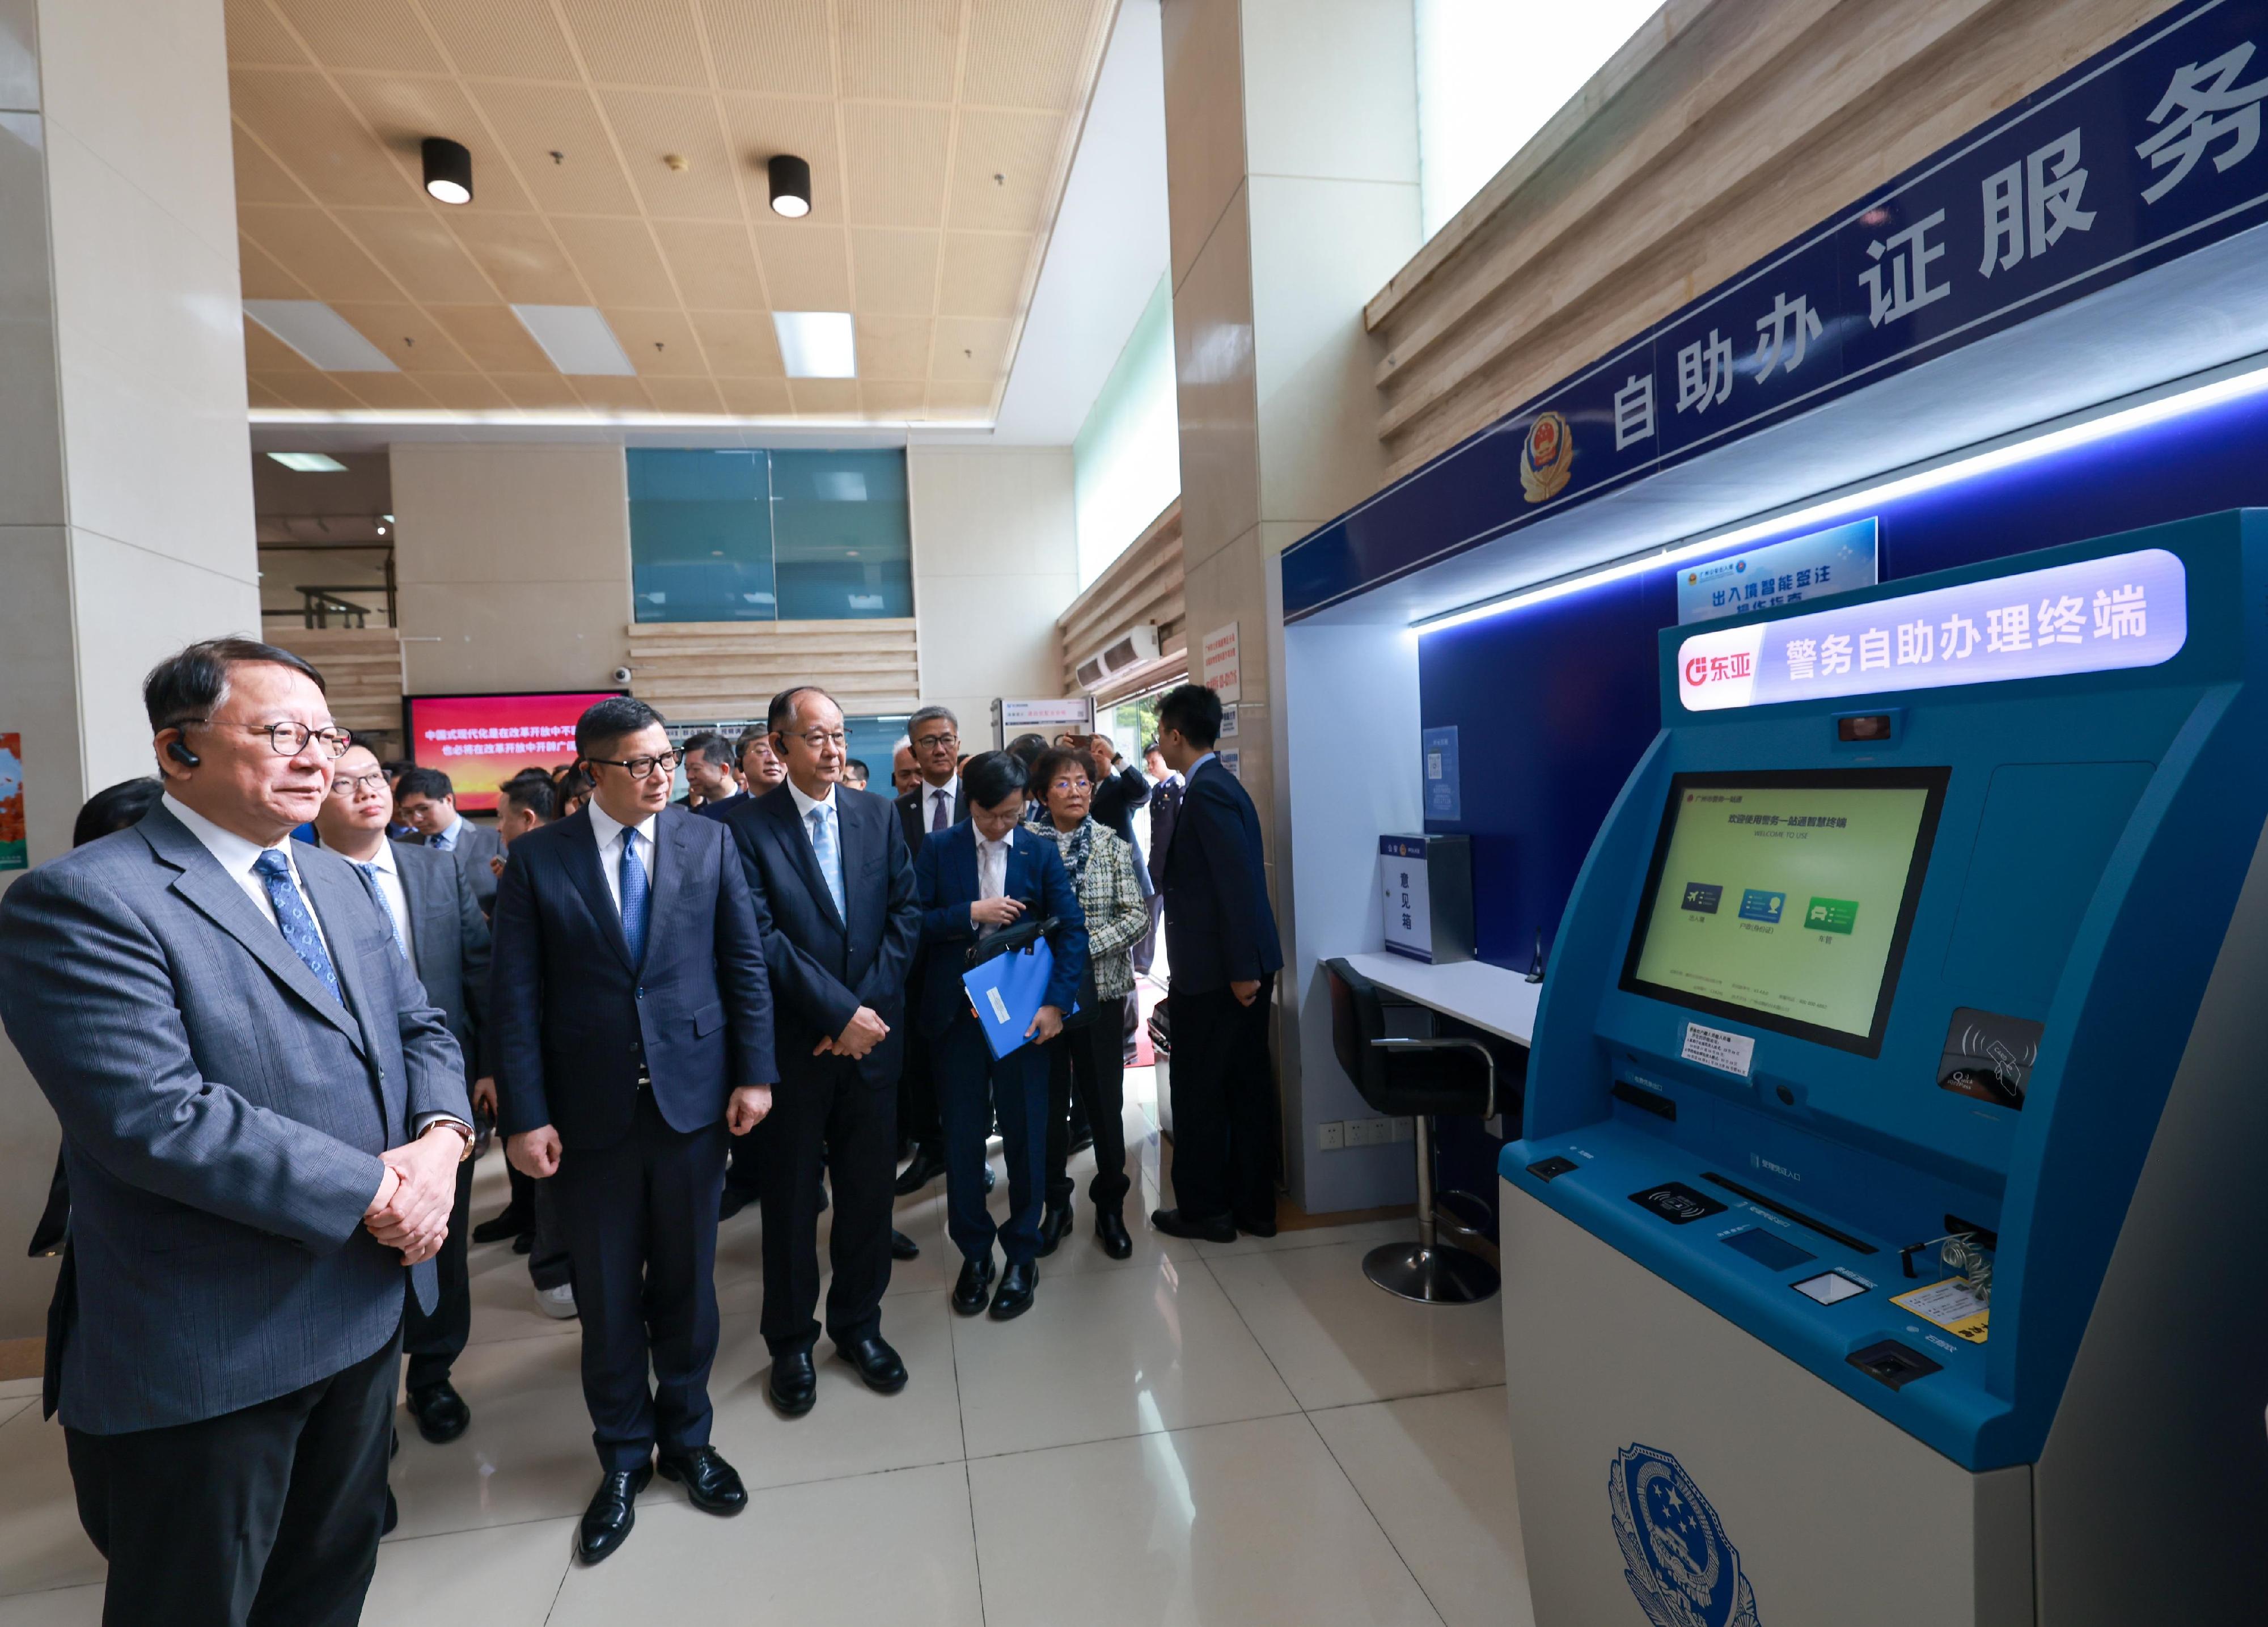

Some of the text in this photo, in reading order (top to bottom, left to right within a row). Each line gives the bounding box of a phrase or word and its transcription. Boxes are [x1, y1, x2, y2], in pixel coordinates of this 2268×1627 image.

[1614, 40, 2268, 451] 自助办证服务
[1712, 565, 1831, 607] 出入境智能签注
[1787, 584, 2148, 681] 警务自助办理终端
[1710, 650, 1751, 682] 东亚
[1728, 814, 1848, 829] 欢迎使用警务一站通智慧终端
[1754, 830, 1784, 839] WELCOME
[1400, 872, 1412, 930] 意见箱
[1818, 935, 1833, 945] 车管
[1994, 1047, 2007, 1061] CARD
[1953, 1071, 1973, 1084] Quick
